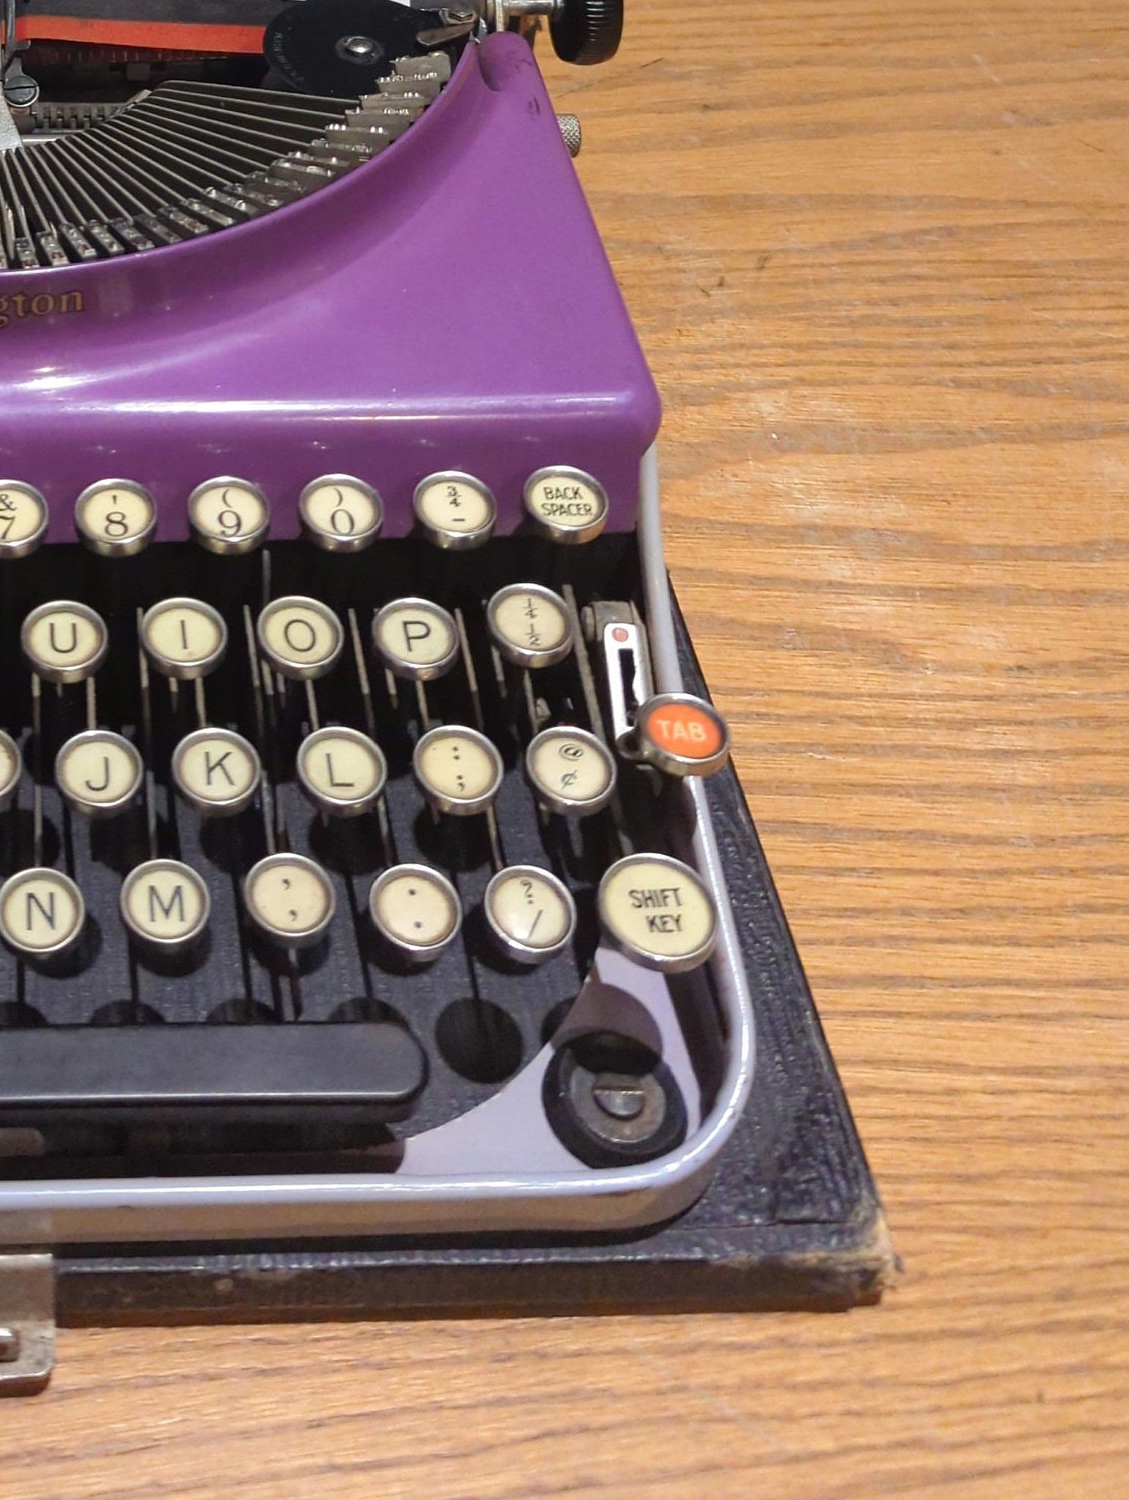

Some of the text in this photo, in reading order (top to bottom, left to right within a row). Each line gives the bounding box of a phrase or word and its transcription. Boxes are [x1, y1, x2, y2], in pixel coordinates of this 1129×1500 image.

[543, 485, 583, 501] BACK
[541, 502, 593, 517] SPACER
[104, 511, 128, 537] 8
[217, 510, 242, 536] 9
[49, 622, 77, 654] U
[402, 620, 431, 652] P
[656, 719, 707, 743] TAB
[558, 743, 584, 761] @
[85, 756, 110, 792] J
[204, 750, 235, 787] K
[326, 753, 355, 788] L
[147, 885, 186, 922] M
[520, 879, 534, 905] ?
[628, 887, 683, 908] SHIFT
[25, 891, 56, 931] N
[648, 914, 683, 933] KEY
